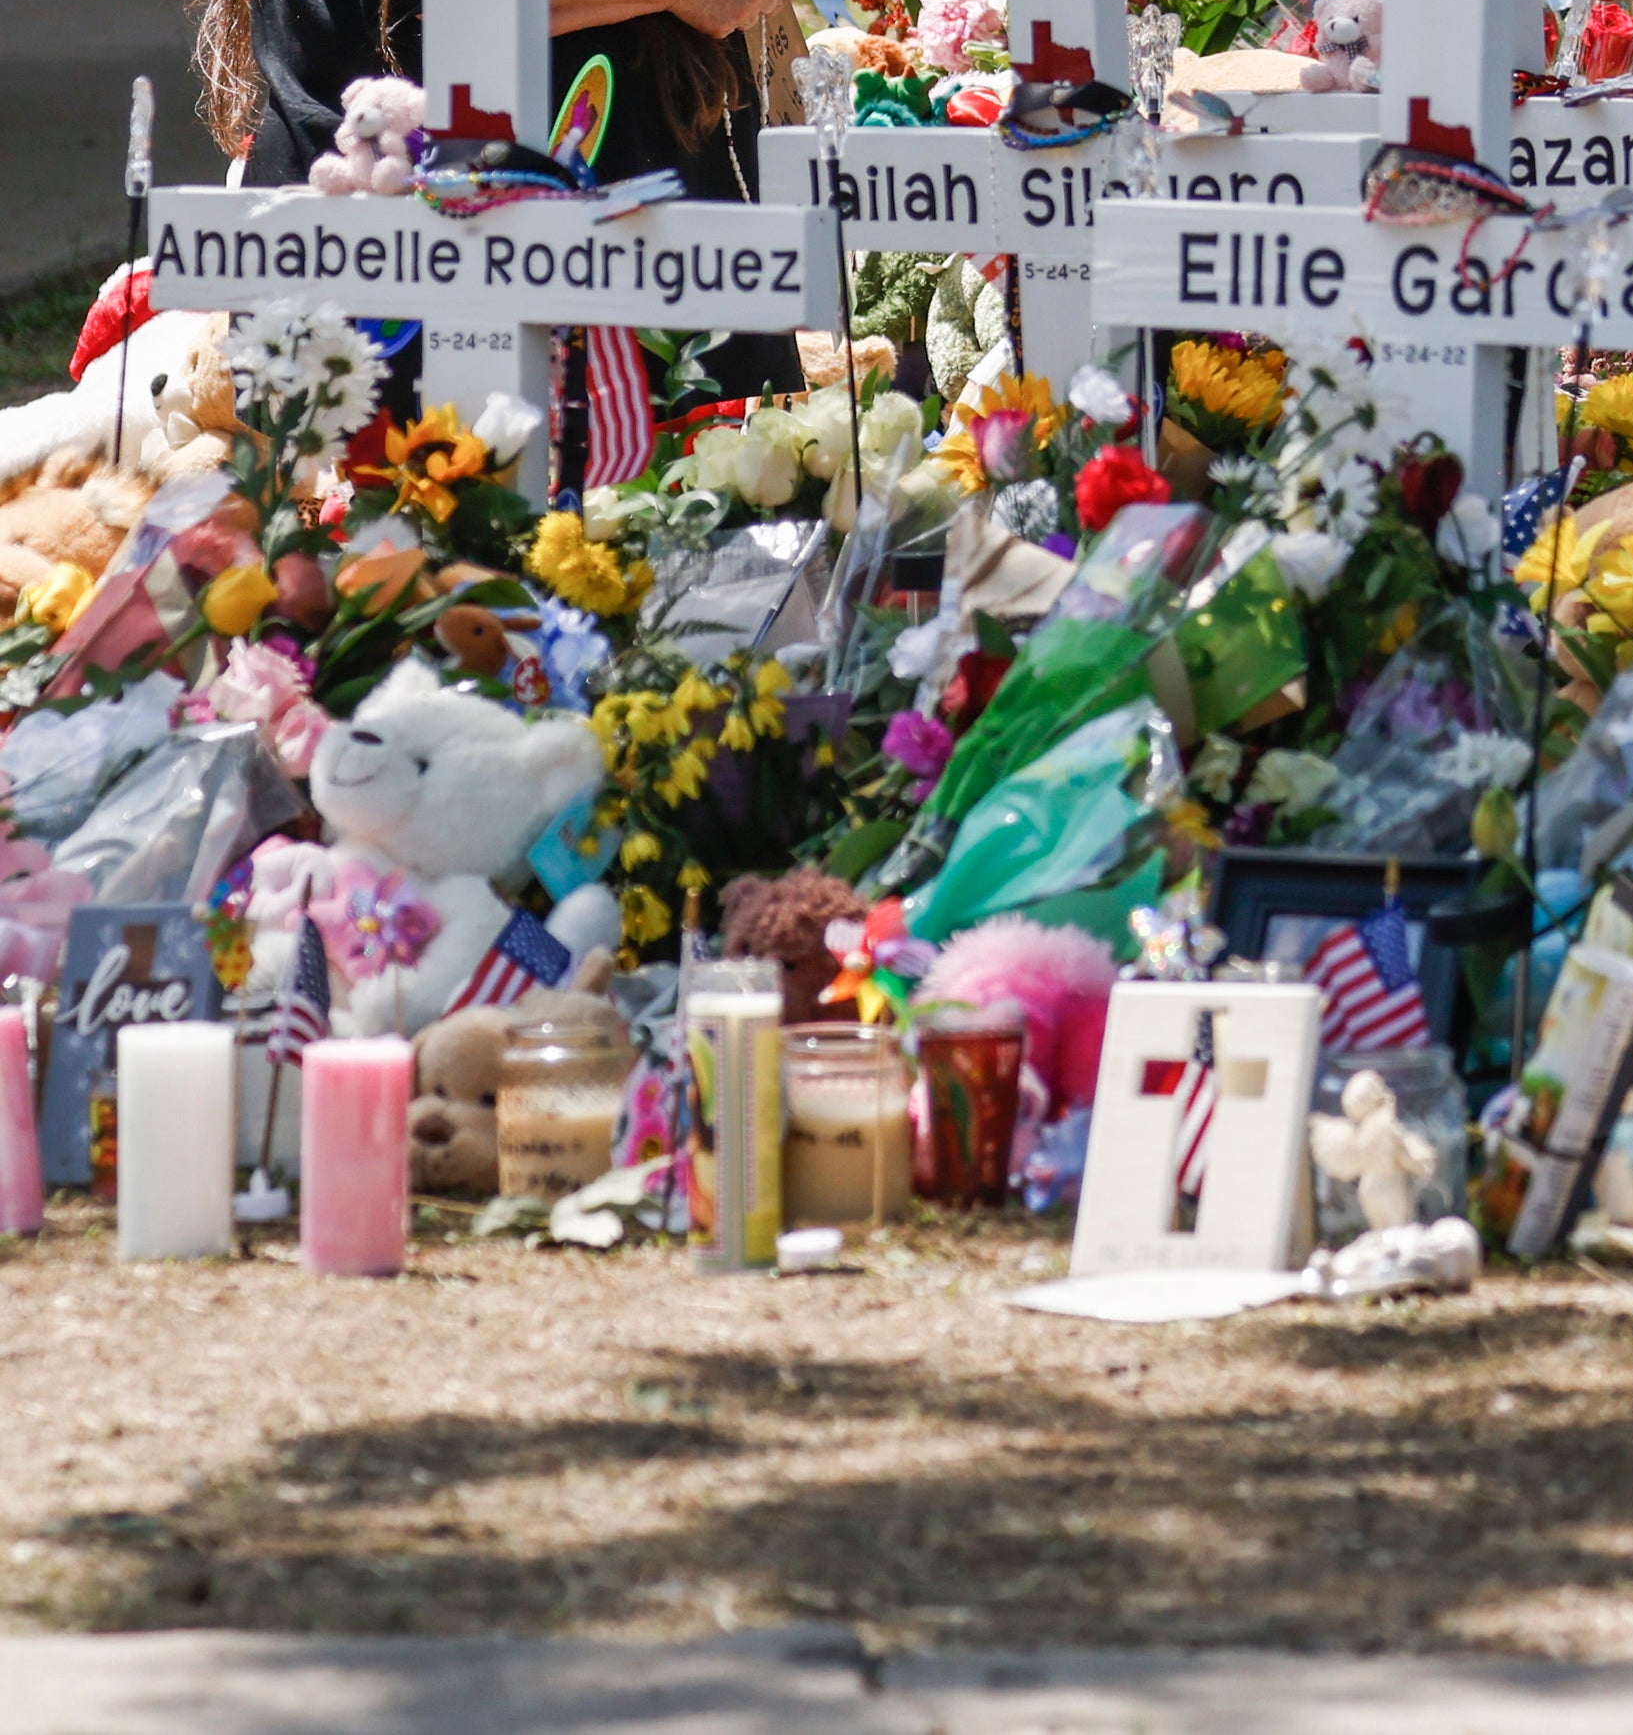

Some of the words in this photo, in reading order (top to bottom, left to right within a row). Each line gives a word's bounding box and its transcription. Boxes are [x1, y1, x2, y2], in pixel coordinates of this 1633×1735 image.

[152, 223, 463, 286] Annabelle
[483, 234, 801, 305] Rodriguez
[1024, 263, 1091, 283] 5-24-2
[1178, 232, 1345, 308] Ellie
[428, 330, 514, 355] 5-24-22
[1382, 344, 1467, 368] 5-24-22
[53, 943, 194, 1037] love
